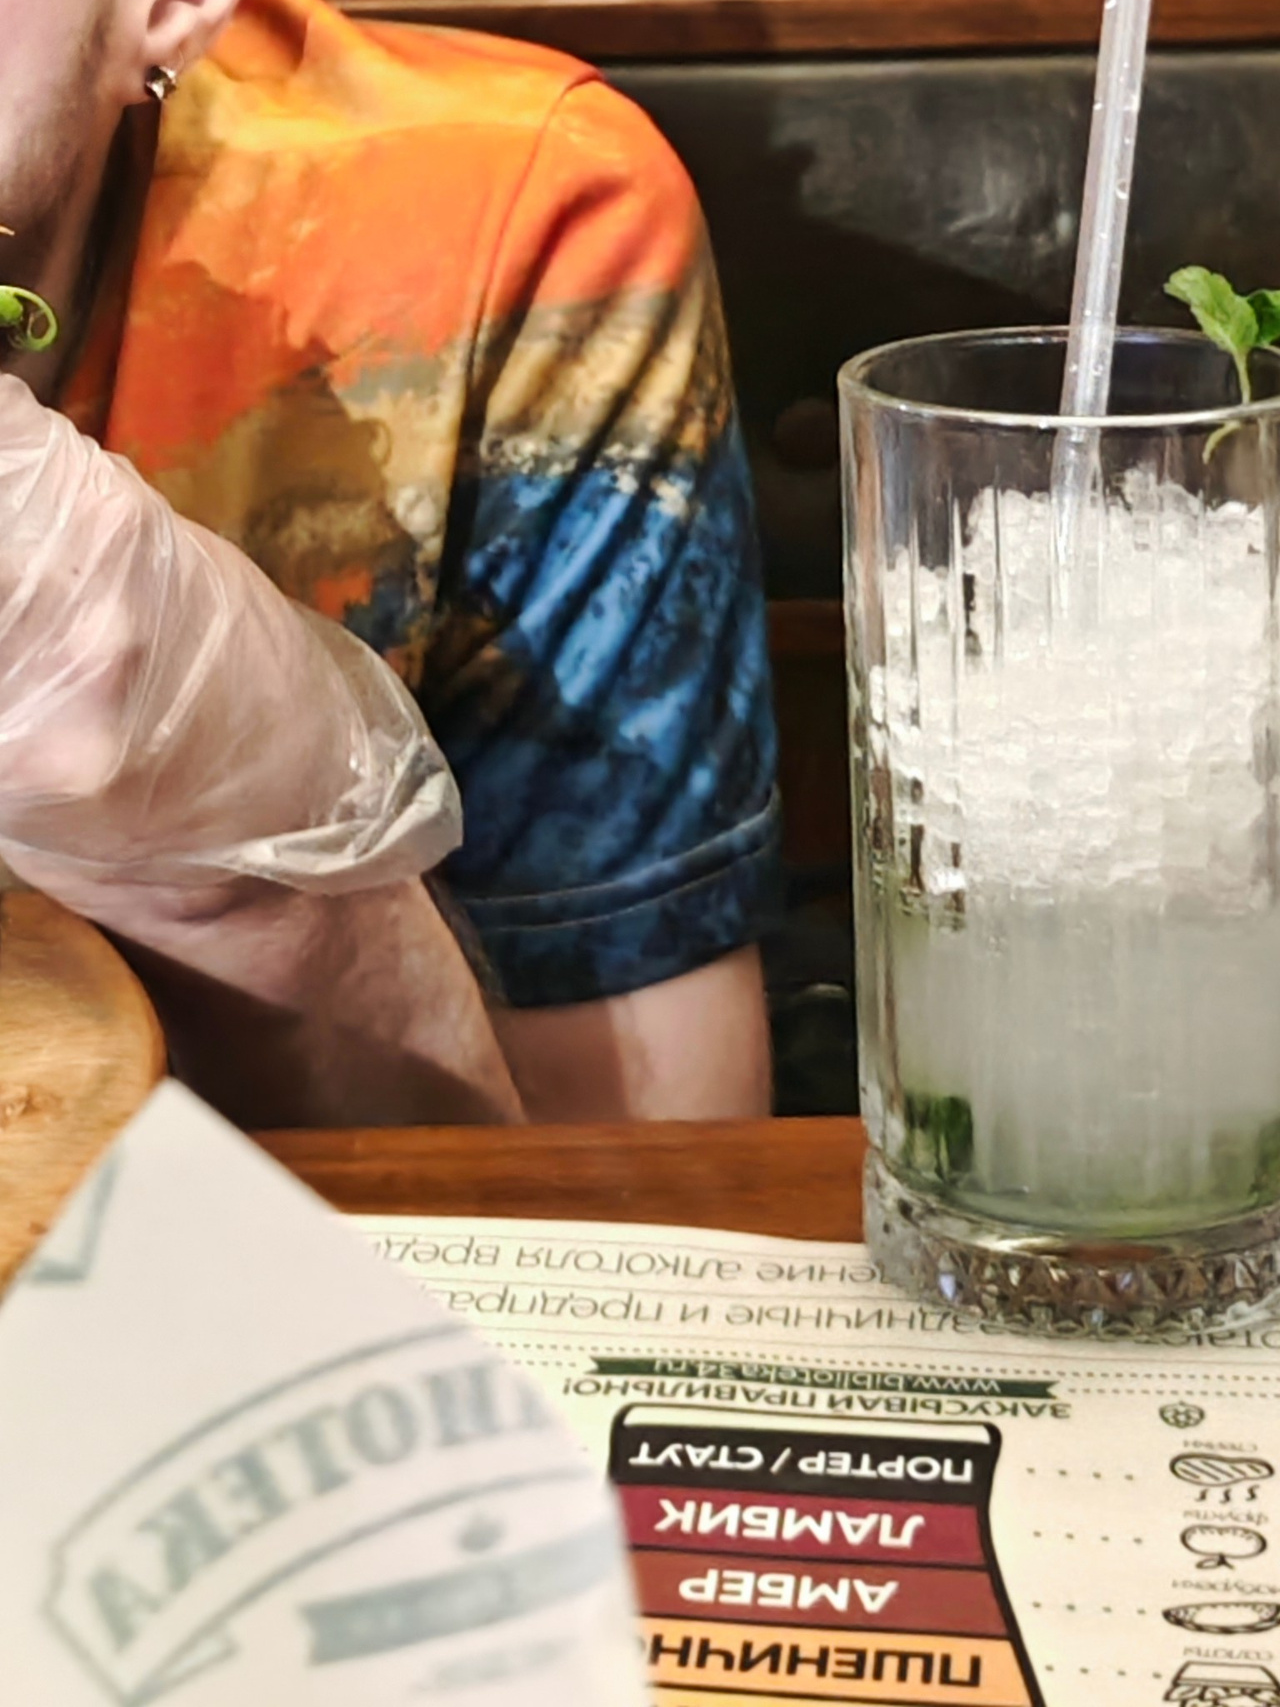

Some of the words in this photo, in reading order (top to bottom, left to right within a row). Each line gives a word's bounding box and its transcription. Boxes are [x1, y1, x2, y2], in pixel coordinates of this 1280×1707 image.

[375, 1234, 501, 1267] вред
[516, 1244, 742, 1281] алкоголя
[681, 1304, 709, 1324] и
[655, 1359, 1003, 1393] www.biblioteka34.ru
[562, 1377, 805, 1408] ПРАВИЛЬНО!
[827, 1395, 1072, 1421] ЗАКУСЫВАЙ
[628, 1441, 764, 1470] СТАУТ
[770, 1447, 792, 1474] /
[798, 1451, 973, 1483] ПОРТЕР
[654, 1498, 926, 1549] ЛАМБИК
[677, 1568, 900, 1614] АМБЕР
